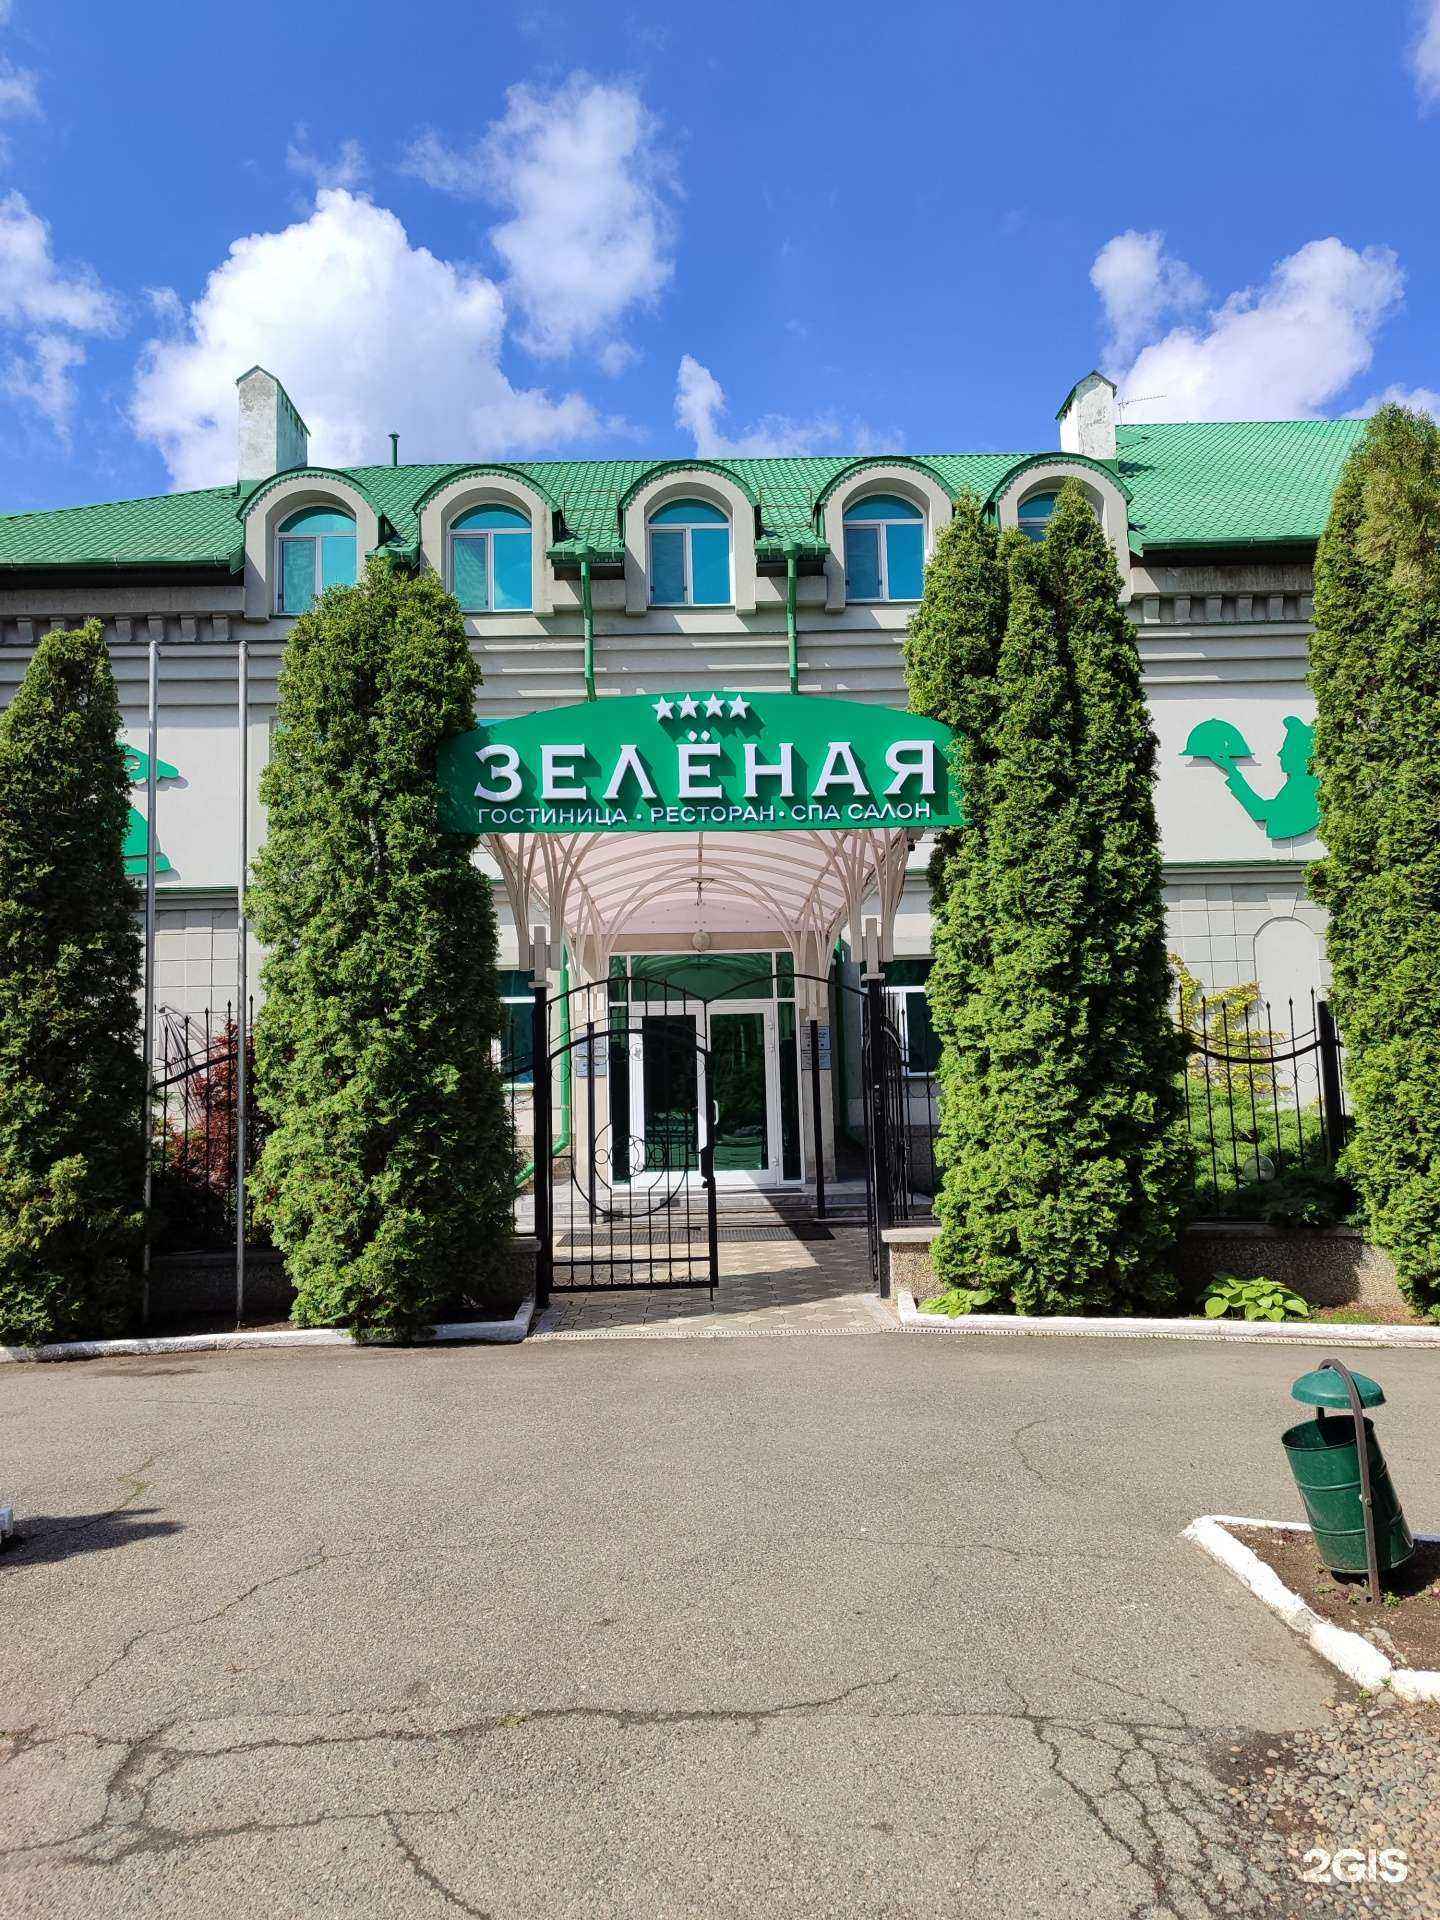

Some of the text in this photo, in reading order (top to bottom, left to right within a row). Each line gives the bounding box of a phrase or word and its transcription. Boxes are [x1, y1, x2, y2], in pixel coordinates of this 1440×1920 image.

[474, 730, 936, 803] ЗЕЛЁНАЯ
[478, 802, 931, 826] ГОСТИНИЦА РЕСТОРАН СПА САЛОН
